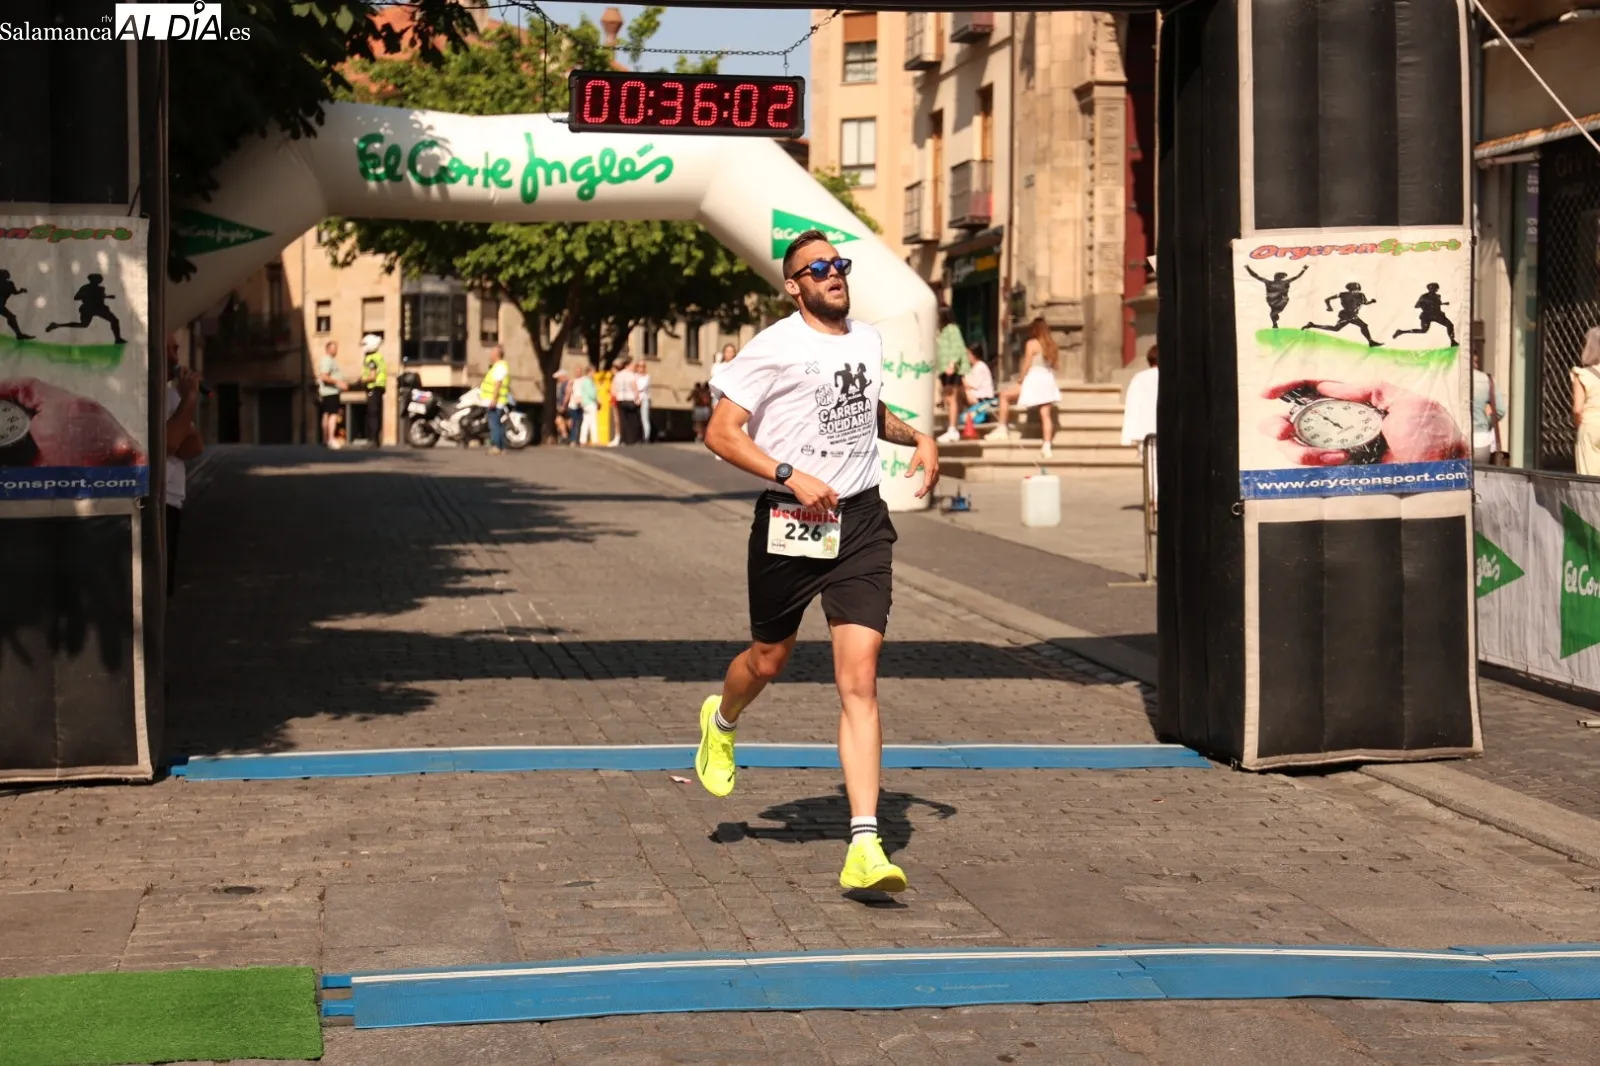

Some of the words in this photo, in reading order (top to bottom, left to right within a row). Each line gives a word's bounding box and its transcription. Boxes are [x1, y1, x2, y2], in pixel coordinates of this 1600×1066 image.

[583, 79, 794, 129] 00:36:02
[356, 133, 403, 183] El
[407, 138, 513, 189] Corte
[520, 132, 674, 205] Inglés
[819, 397, 872, 423] CARRERA
[1257, 472, 1467, 490] www.orycronsport.com
[785, 523, 822, 541] 226
[1565, 560, 1578, 593] El
